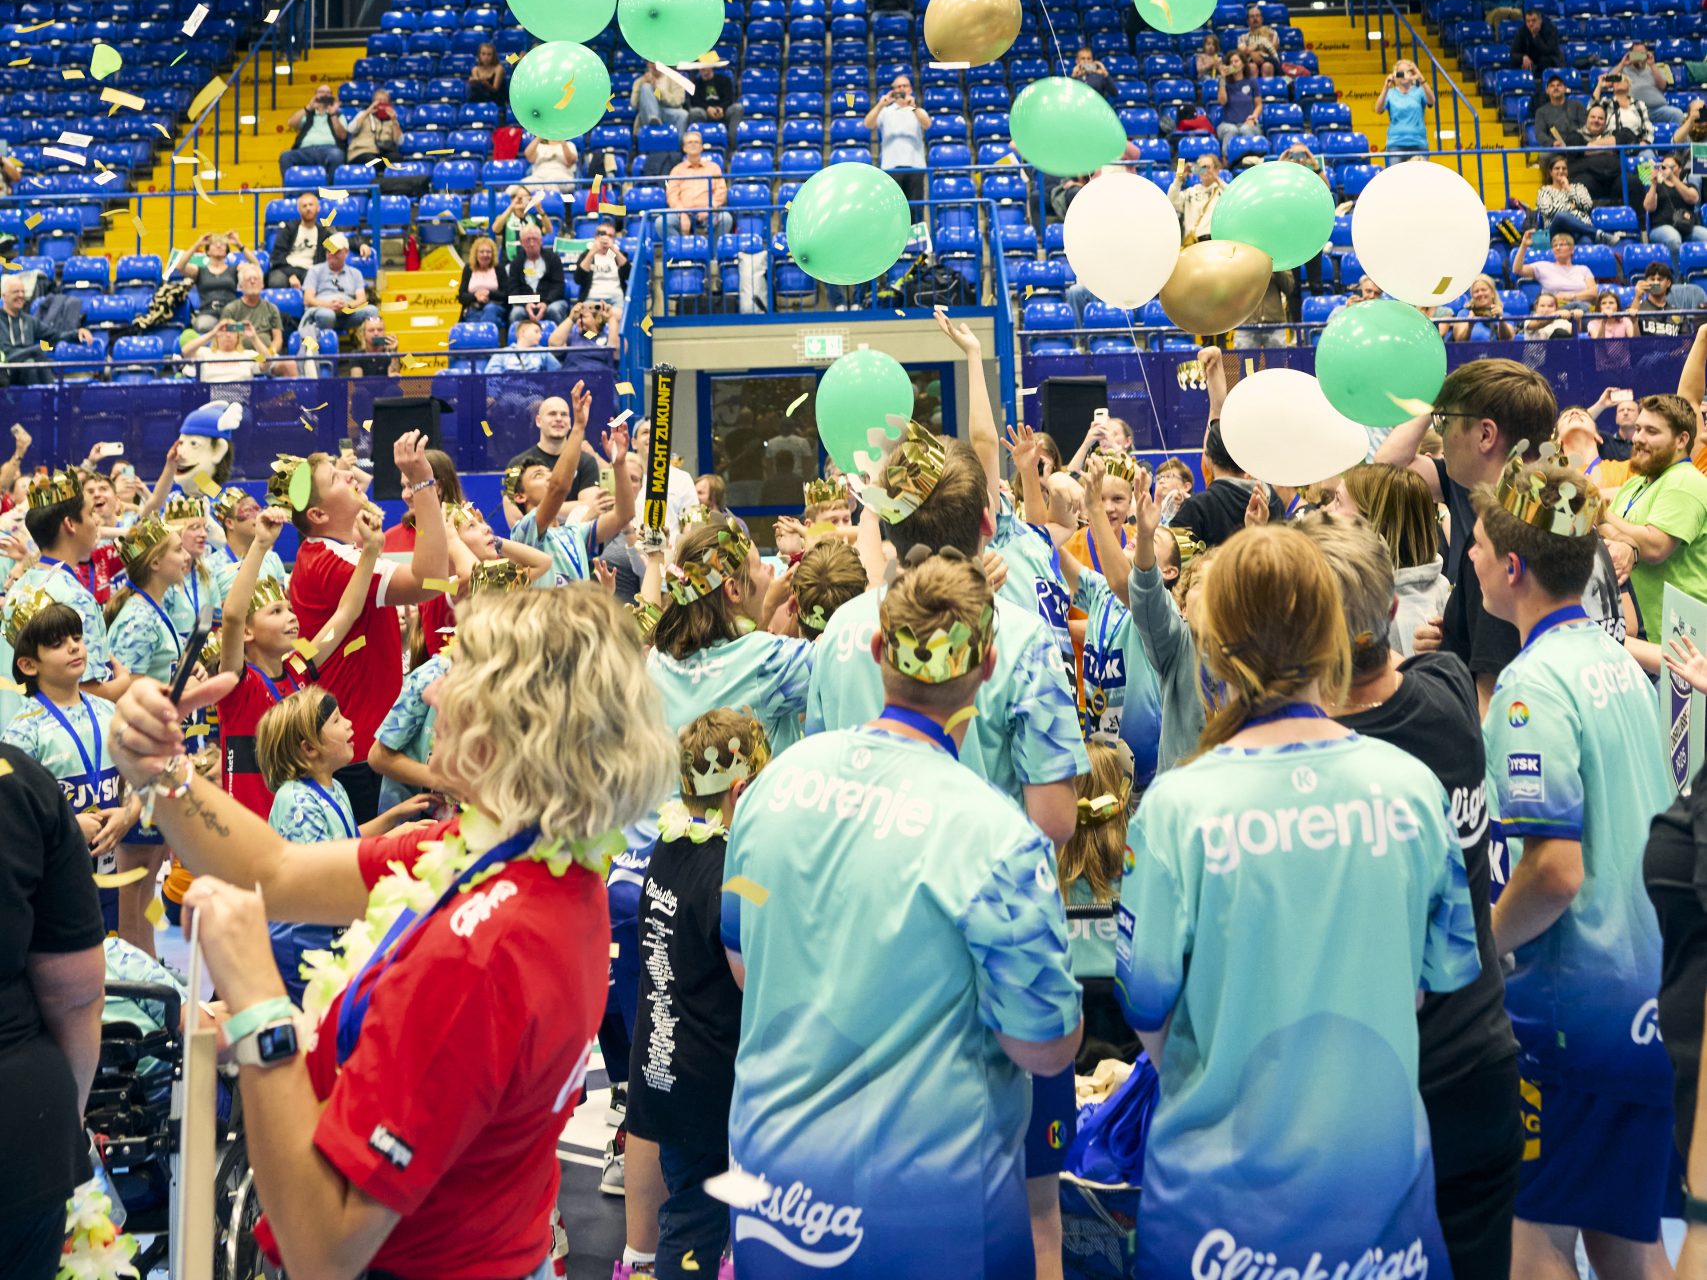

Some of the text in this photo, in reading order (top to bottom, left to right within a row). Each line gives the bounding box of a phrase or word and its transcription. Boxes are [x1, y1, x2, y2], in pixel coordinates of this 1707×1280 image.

[655, 374, 672, 440] ZUKUNFT
[652, 443, 668, 493] MACHT
[73, 775, 120, 808] JYSK
[768, 767, 933, 841] gorenje
[1201, 783, 1420, 874] gorenje
